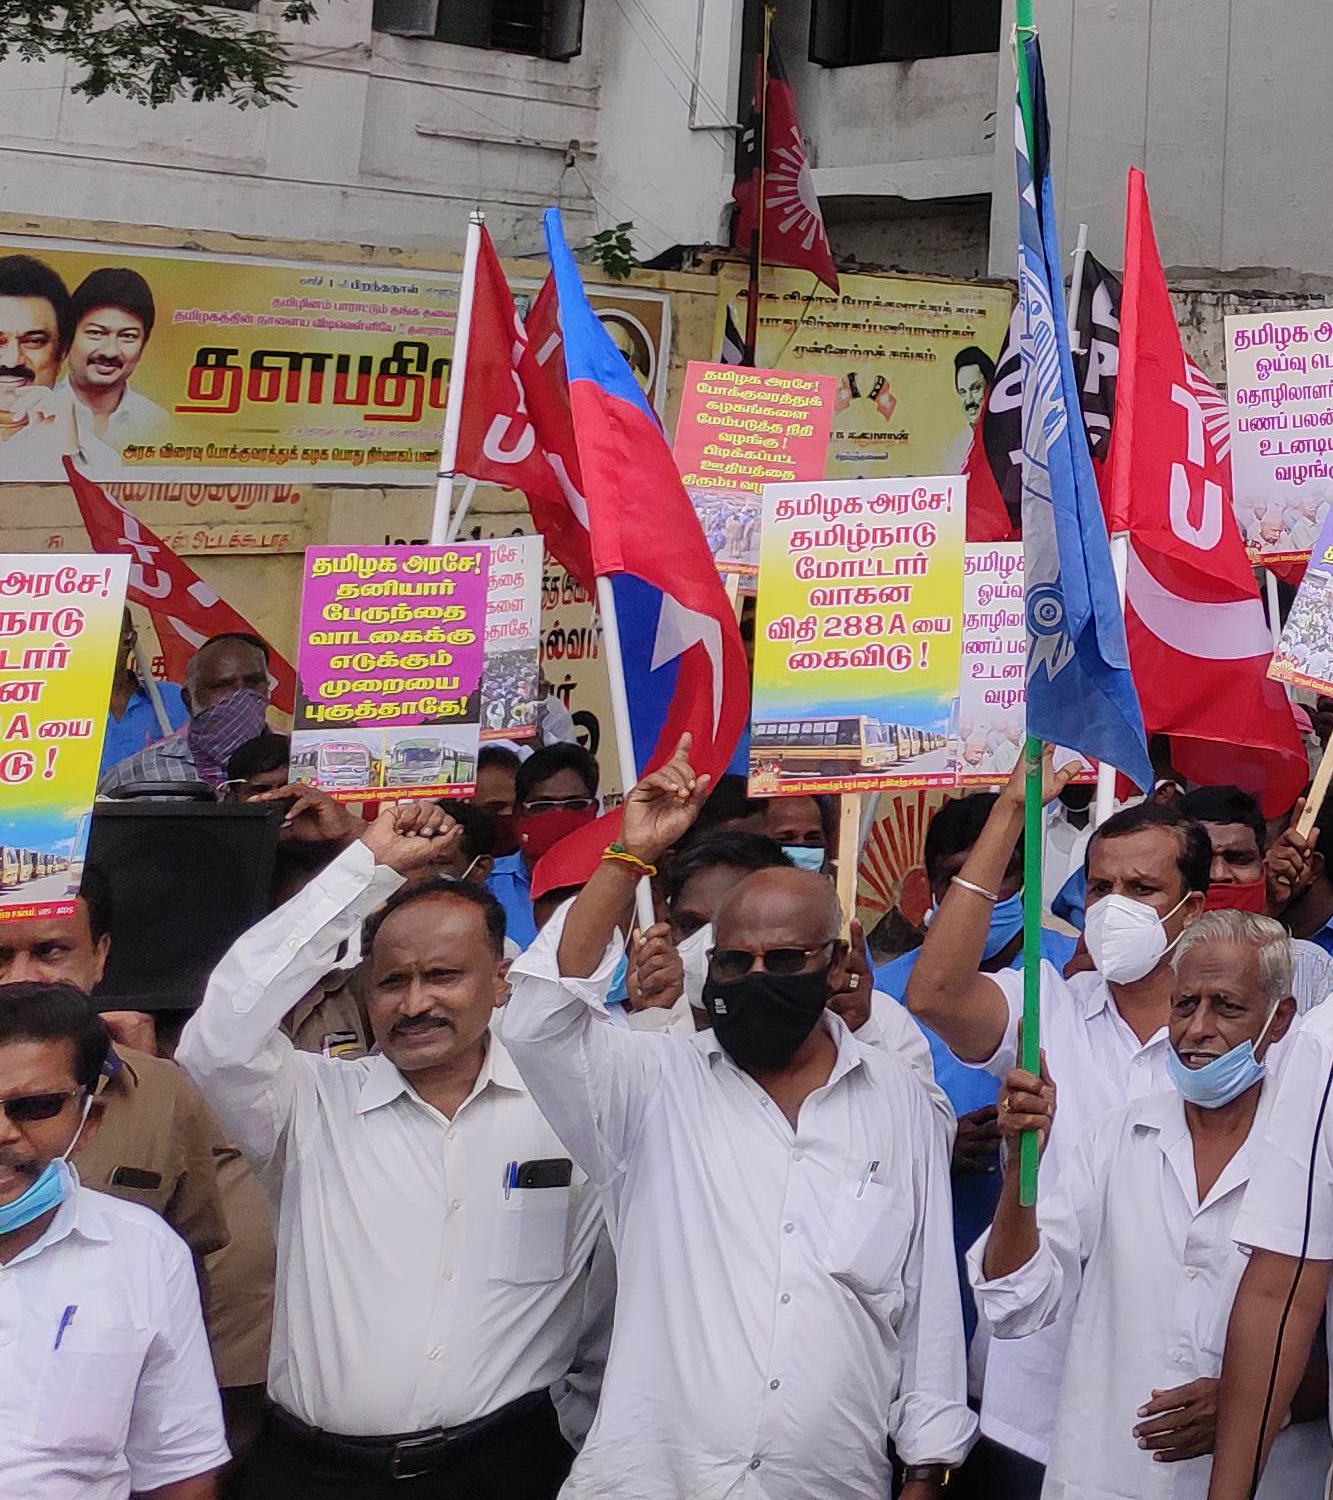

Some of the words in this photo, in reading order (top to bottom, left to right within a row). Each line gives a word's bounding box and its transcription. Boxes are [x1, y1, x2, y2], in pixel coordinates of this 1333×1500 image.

[1234, 321, 1309, 352] தமிழக
[1256, 353, 1307, 381] ஓய்வு
[703, 370, 762, 386] தமிழக
[764, 377, 820, 393] அரசே!
[1238, 411, 1288, 432] பணப்
[774, 492, 863, 523] தமிழக
[867, 487, 953, 515] அரசே!
[789, 521, 937, 554] தமிழ்நாடு
[312, 553, 398, 578] தமிழக
[401, 551, 482, 576] அரசே!
[795, 551, 929, 580] மோட்டார்
[335, 578, 457, 601] தனியார்
[810, 585, 913, 606] வாகன
[321, 602, 467, 624] பேருந்தை
[308, 626, 476, 647] வாடகைக்கு
[767, 615, 818, 645] விதி
[912, 617, 951, 634] யை
[329, 650, 454, 672] எடுக்கும்
[319, 676, 460, 698] முறையை
[304, 696, 469, 722] புகுத்தாதே!
[38, 717, 93, 740] யை
